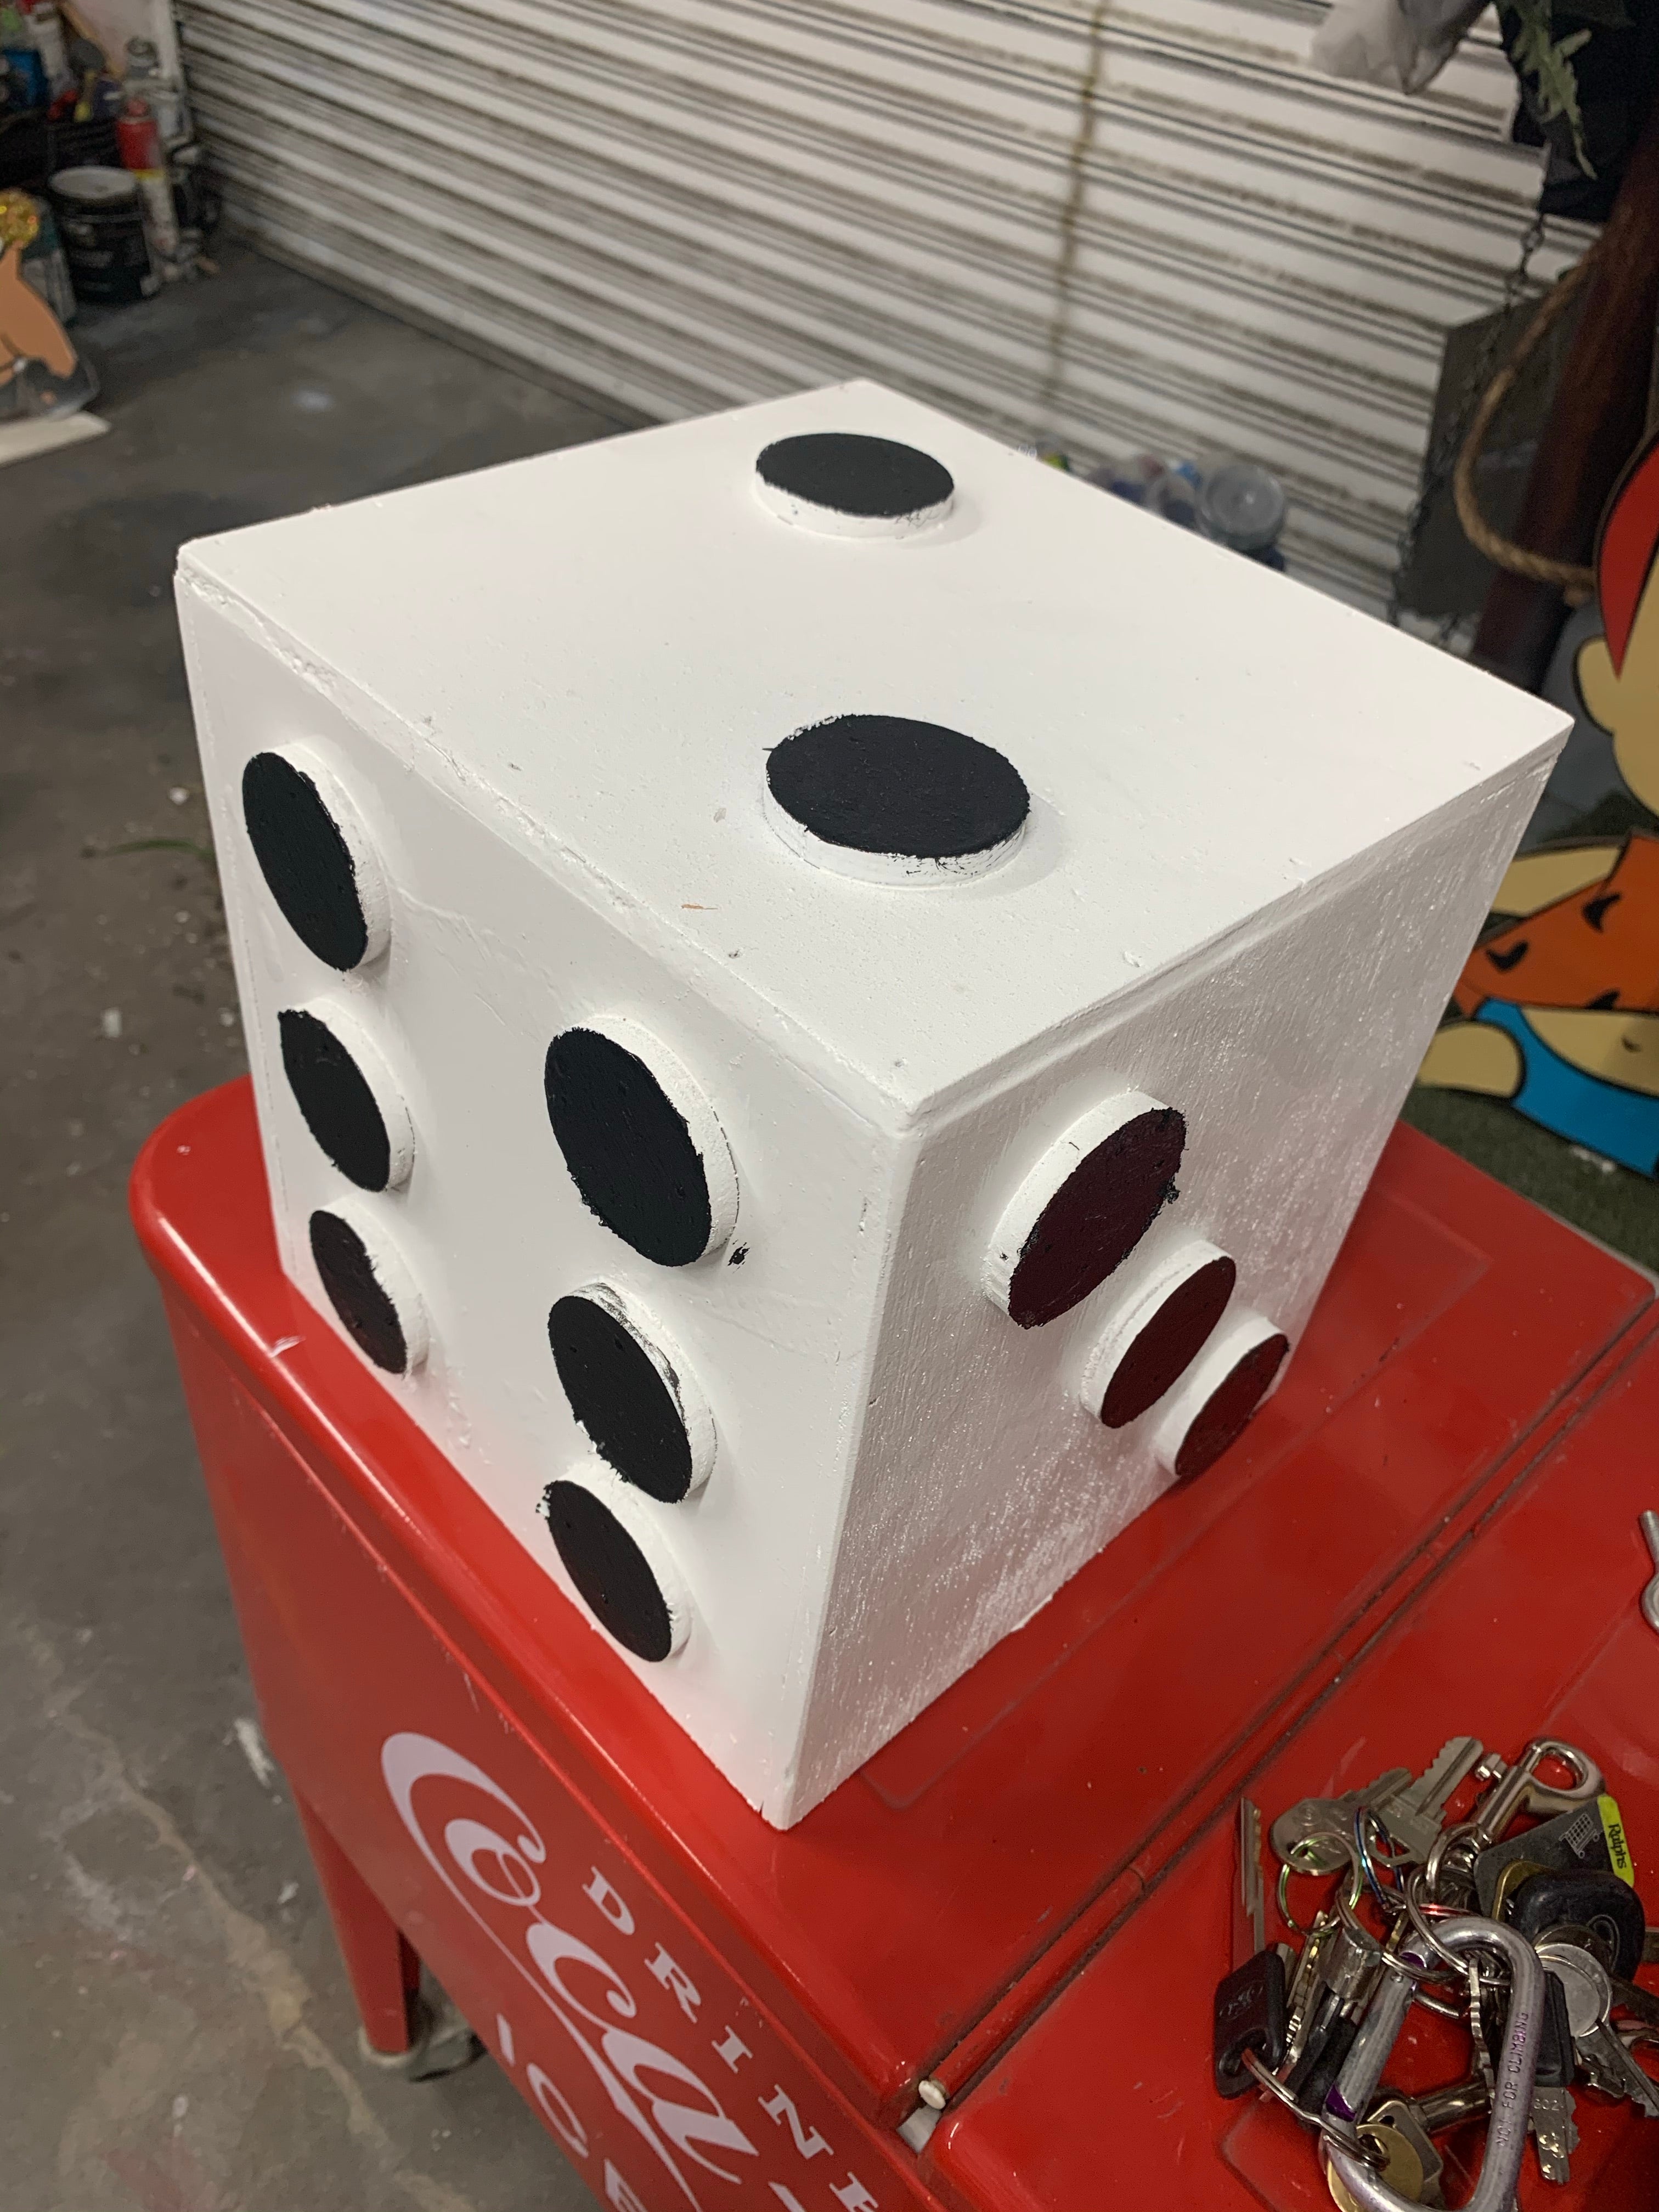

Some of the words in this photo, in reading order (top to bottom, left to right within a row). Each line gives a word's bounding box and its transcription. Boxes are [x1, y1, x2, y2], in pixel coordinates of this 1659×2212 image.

[1608, 1823, 1627, 1869] Ralphs
[1508, 2012, 1529, 2074] CLIMBING
[1502, 2081, 1519, 2109] FOR
[1496, 2119, 1512, 2147] NOT
